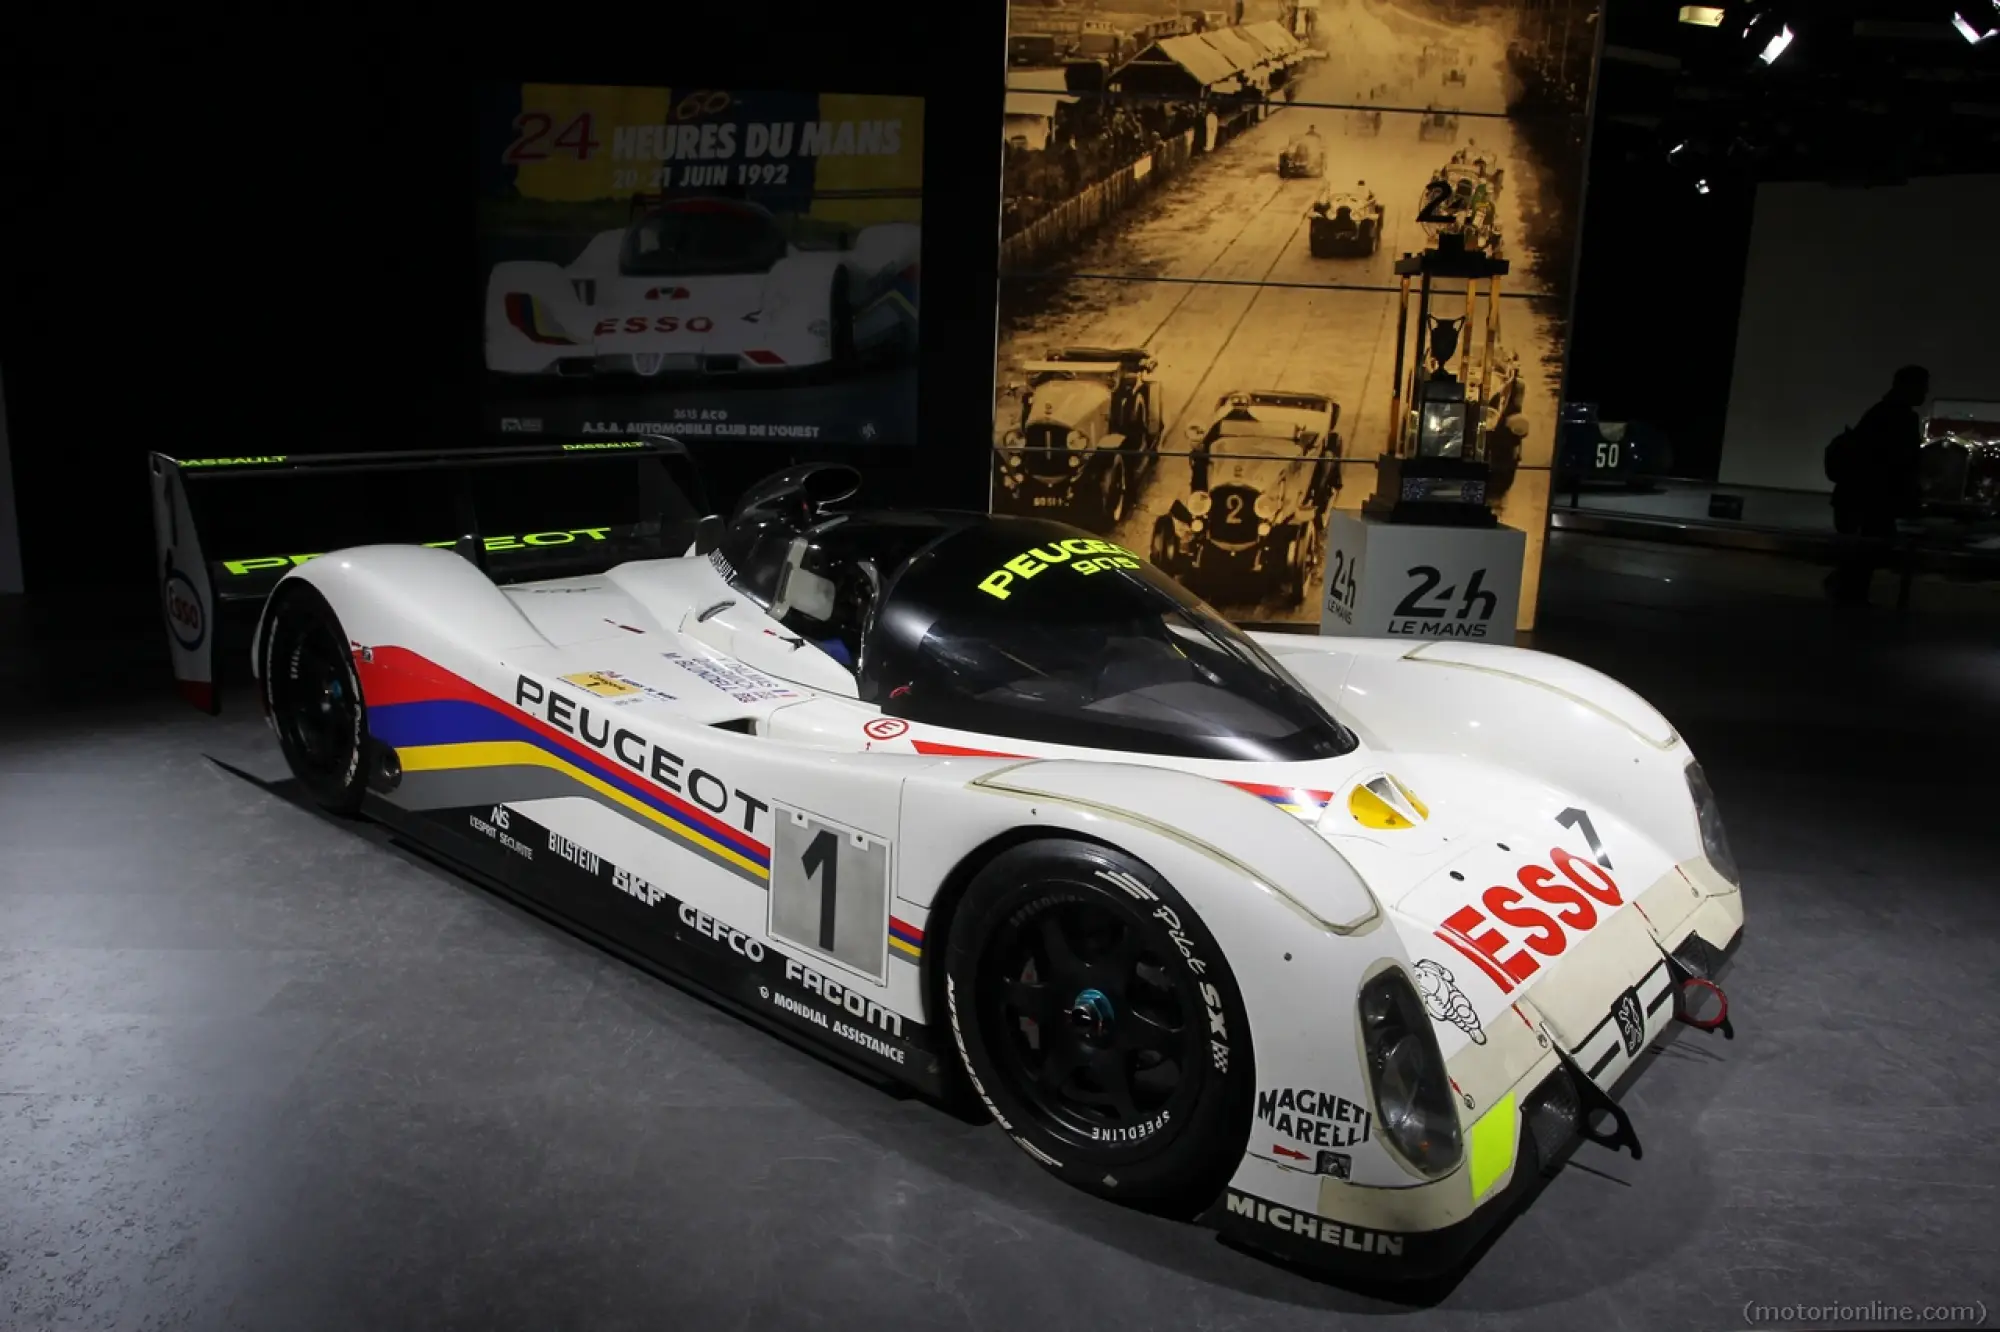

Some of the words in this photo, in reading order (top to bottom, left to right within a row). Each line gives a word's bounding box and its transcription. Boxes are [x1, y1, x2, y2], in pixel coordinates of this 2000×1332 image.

[505, 111, 600, 164] 24
[612, 122, 737, 162] HEURES
[744, 122, 795, 159] DU
[798, 119, 901, 157] MANS
[678, 164, 729, 188] JUIN
[736, 163, 790, 186] 1992
[594, 316, 714, 336] ESSO
[626, 421, 713, 436] AUTOMOBILE
[715, 423, 748, 436] CLUB
[750, 424, 767, 437] DE
[768, 424, 820, 438] L'OUEST
[700, 408, 728, 421] ACO
[1595, 442, 1619, 469] 50
[1225, 494, 1242, 524] 2
[222, 526, 612, 576] PEOT
[977, 537, 1140, 601] PEUGE
[1071, 557, 1140, 576] 905
[1393, 565, 1498, 620] 24h
[1387, 619, 1417, 635] LE
[1419, 621, 1488, 637] MANS
[516, 674, 769, 833] PEUGEOT
[548, 830, 600, 877] BILSTEIN
[1554, 806, 1614, 870] 1
[612, 864, 667, 907] SKF
[801, 829, 839, 953] 1
[678, 900, 765, 964] GEFCO
[1433, 846, 1625, 994] ESSO
[1152, 905, 1207, 975] Pilot
[1198, 980, 1229, 1041] SX
[774, 991, 829, 1029] MONDIAL
[832, 1019, 906, 1065] ASSISTANCE
[1091, 1109, 1171, 1142] SPEEDLINE
[1257, 1087, 1373, 1132] MAGNETI
[1226, 1191, 1404, 1256] MICHELIN
